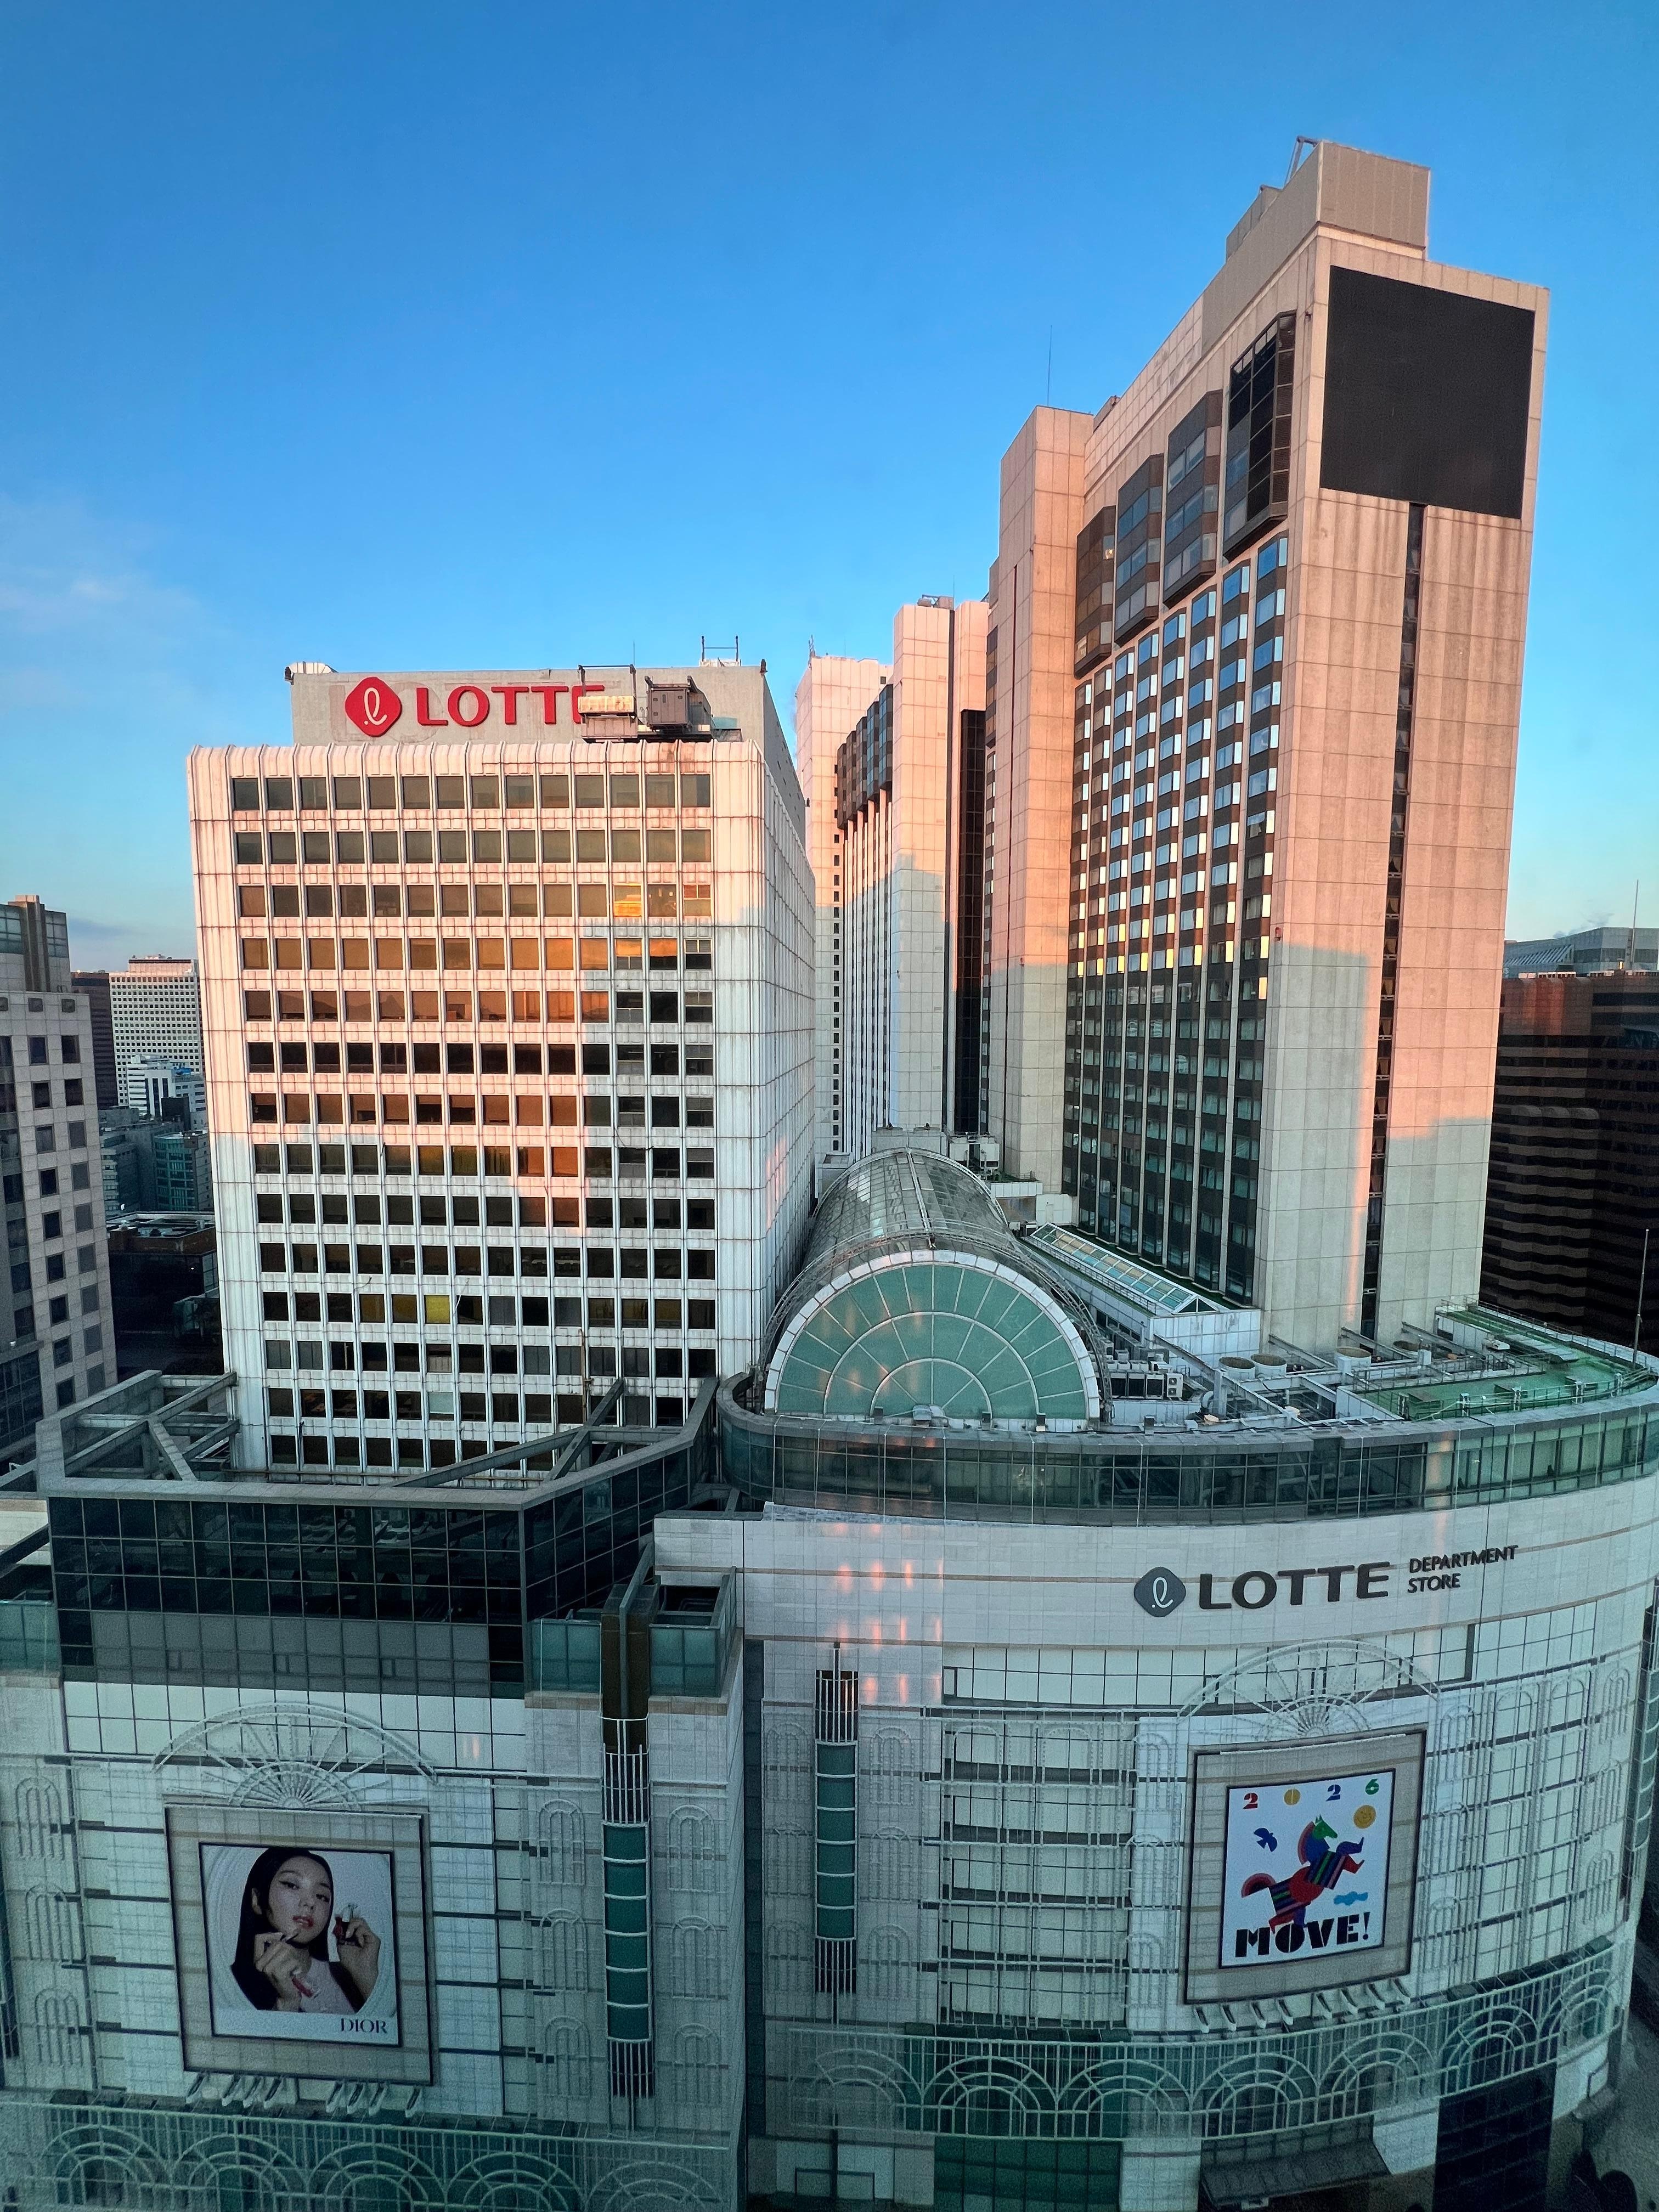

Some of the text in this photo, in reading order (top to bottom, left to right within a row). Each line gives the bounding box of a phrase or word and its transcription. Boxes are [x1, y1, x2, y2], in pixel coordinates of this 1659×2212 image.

[1409, 1545, 1519, 1573] DEPARTMENT
[1199, 1561, 1390, 1610] LOTTE
[1407, 1573, 1462, 1593] STORE
[1235, 1911, 1370, 1957] MOVE!
[341, 2018, 387, 2034] DIOR
